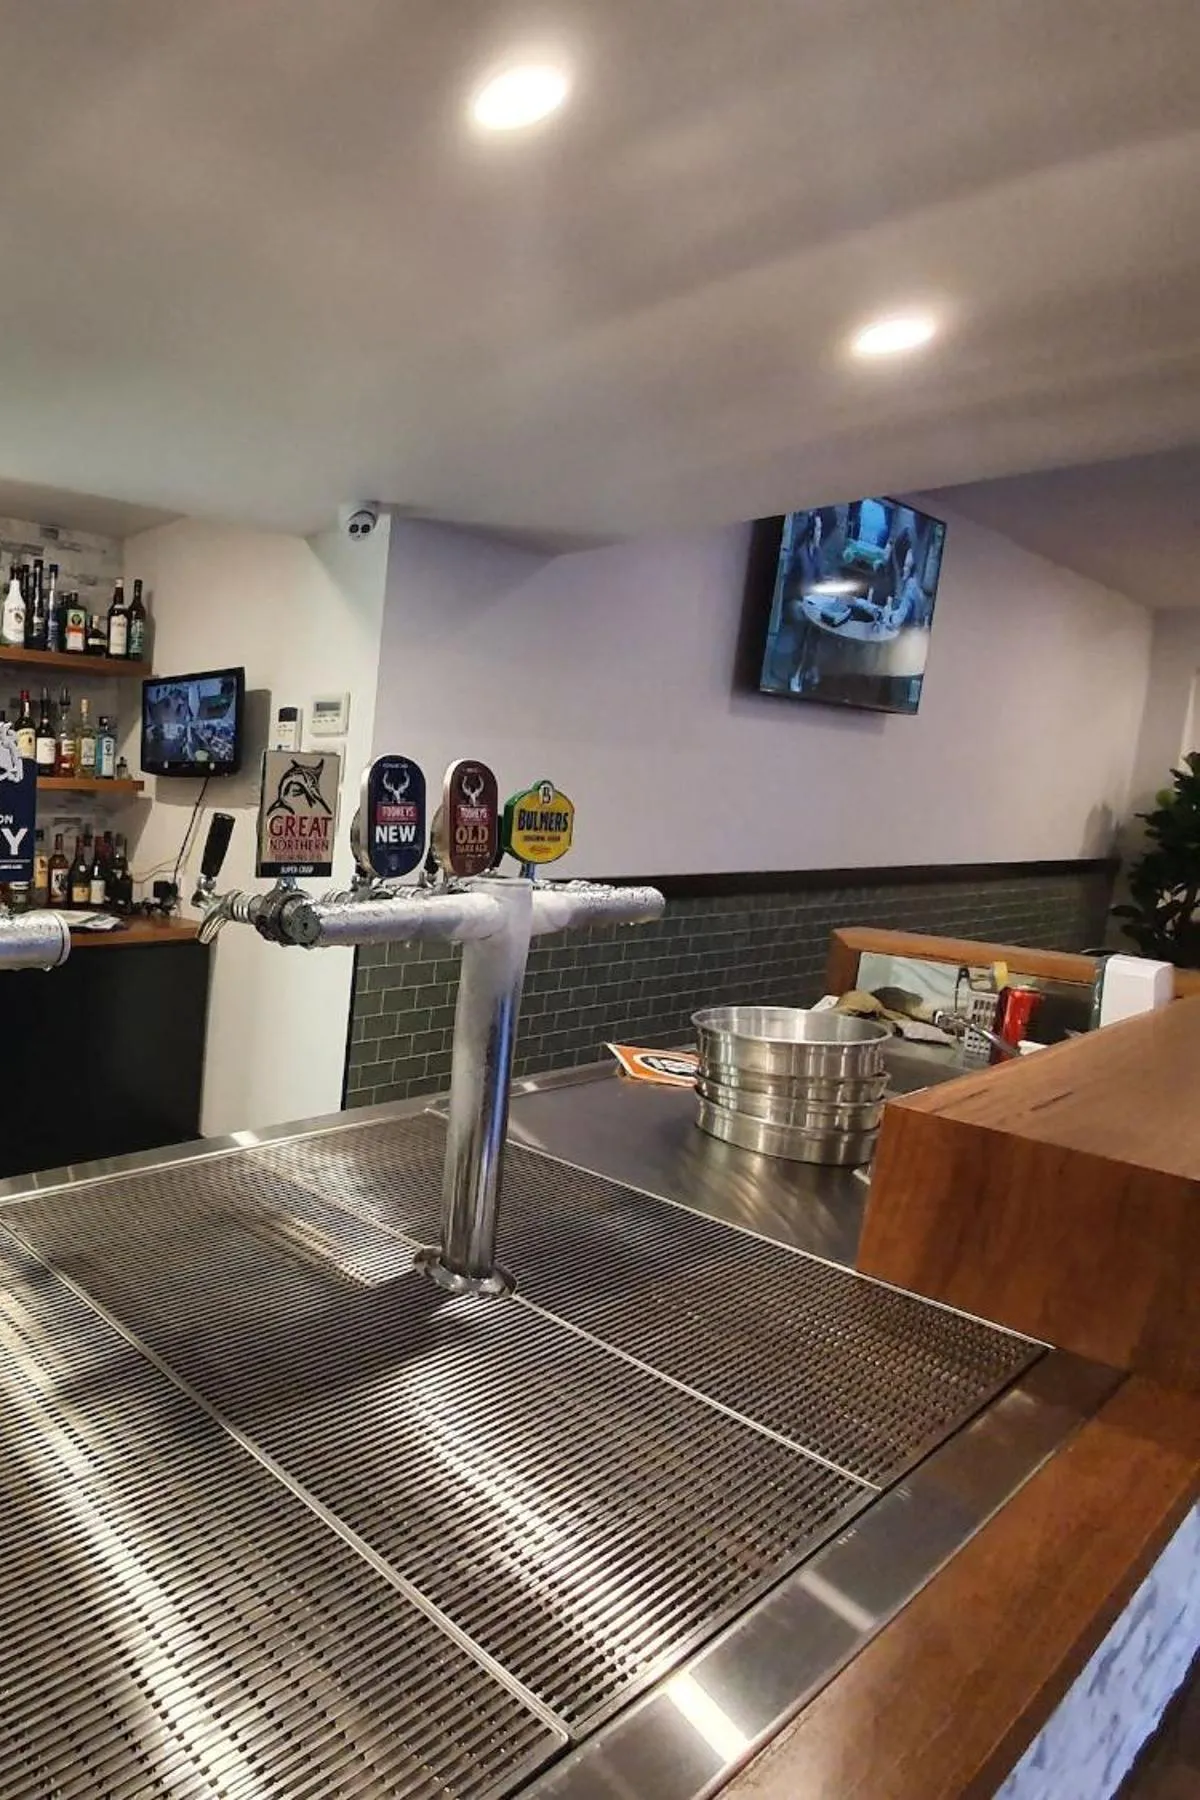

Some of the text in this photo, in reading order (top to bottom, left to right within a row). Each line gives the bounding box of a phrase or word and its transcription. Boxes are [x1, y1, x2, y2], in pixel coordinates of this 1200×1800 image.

[268, 815, 333, 838] GREAT
[517, 808, 569, 833] BULMERS
[375, 825, 417, 844] NEW
[455, 826, 490, 845] OLD
[269, 838, 329, 852] NORTHERN
